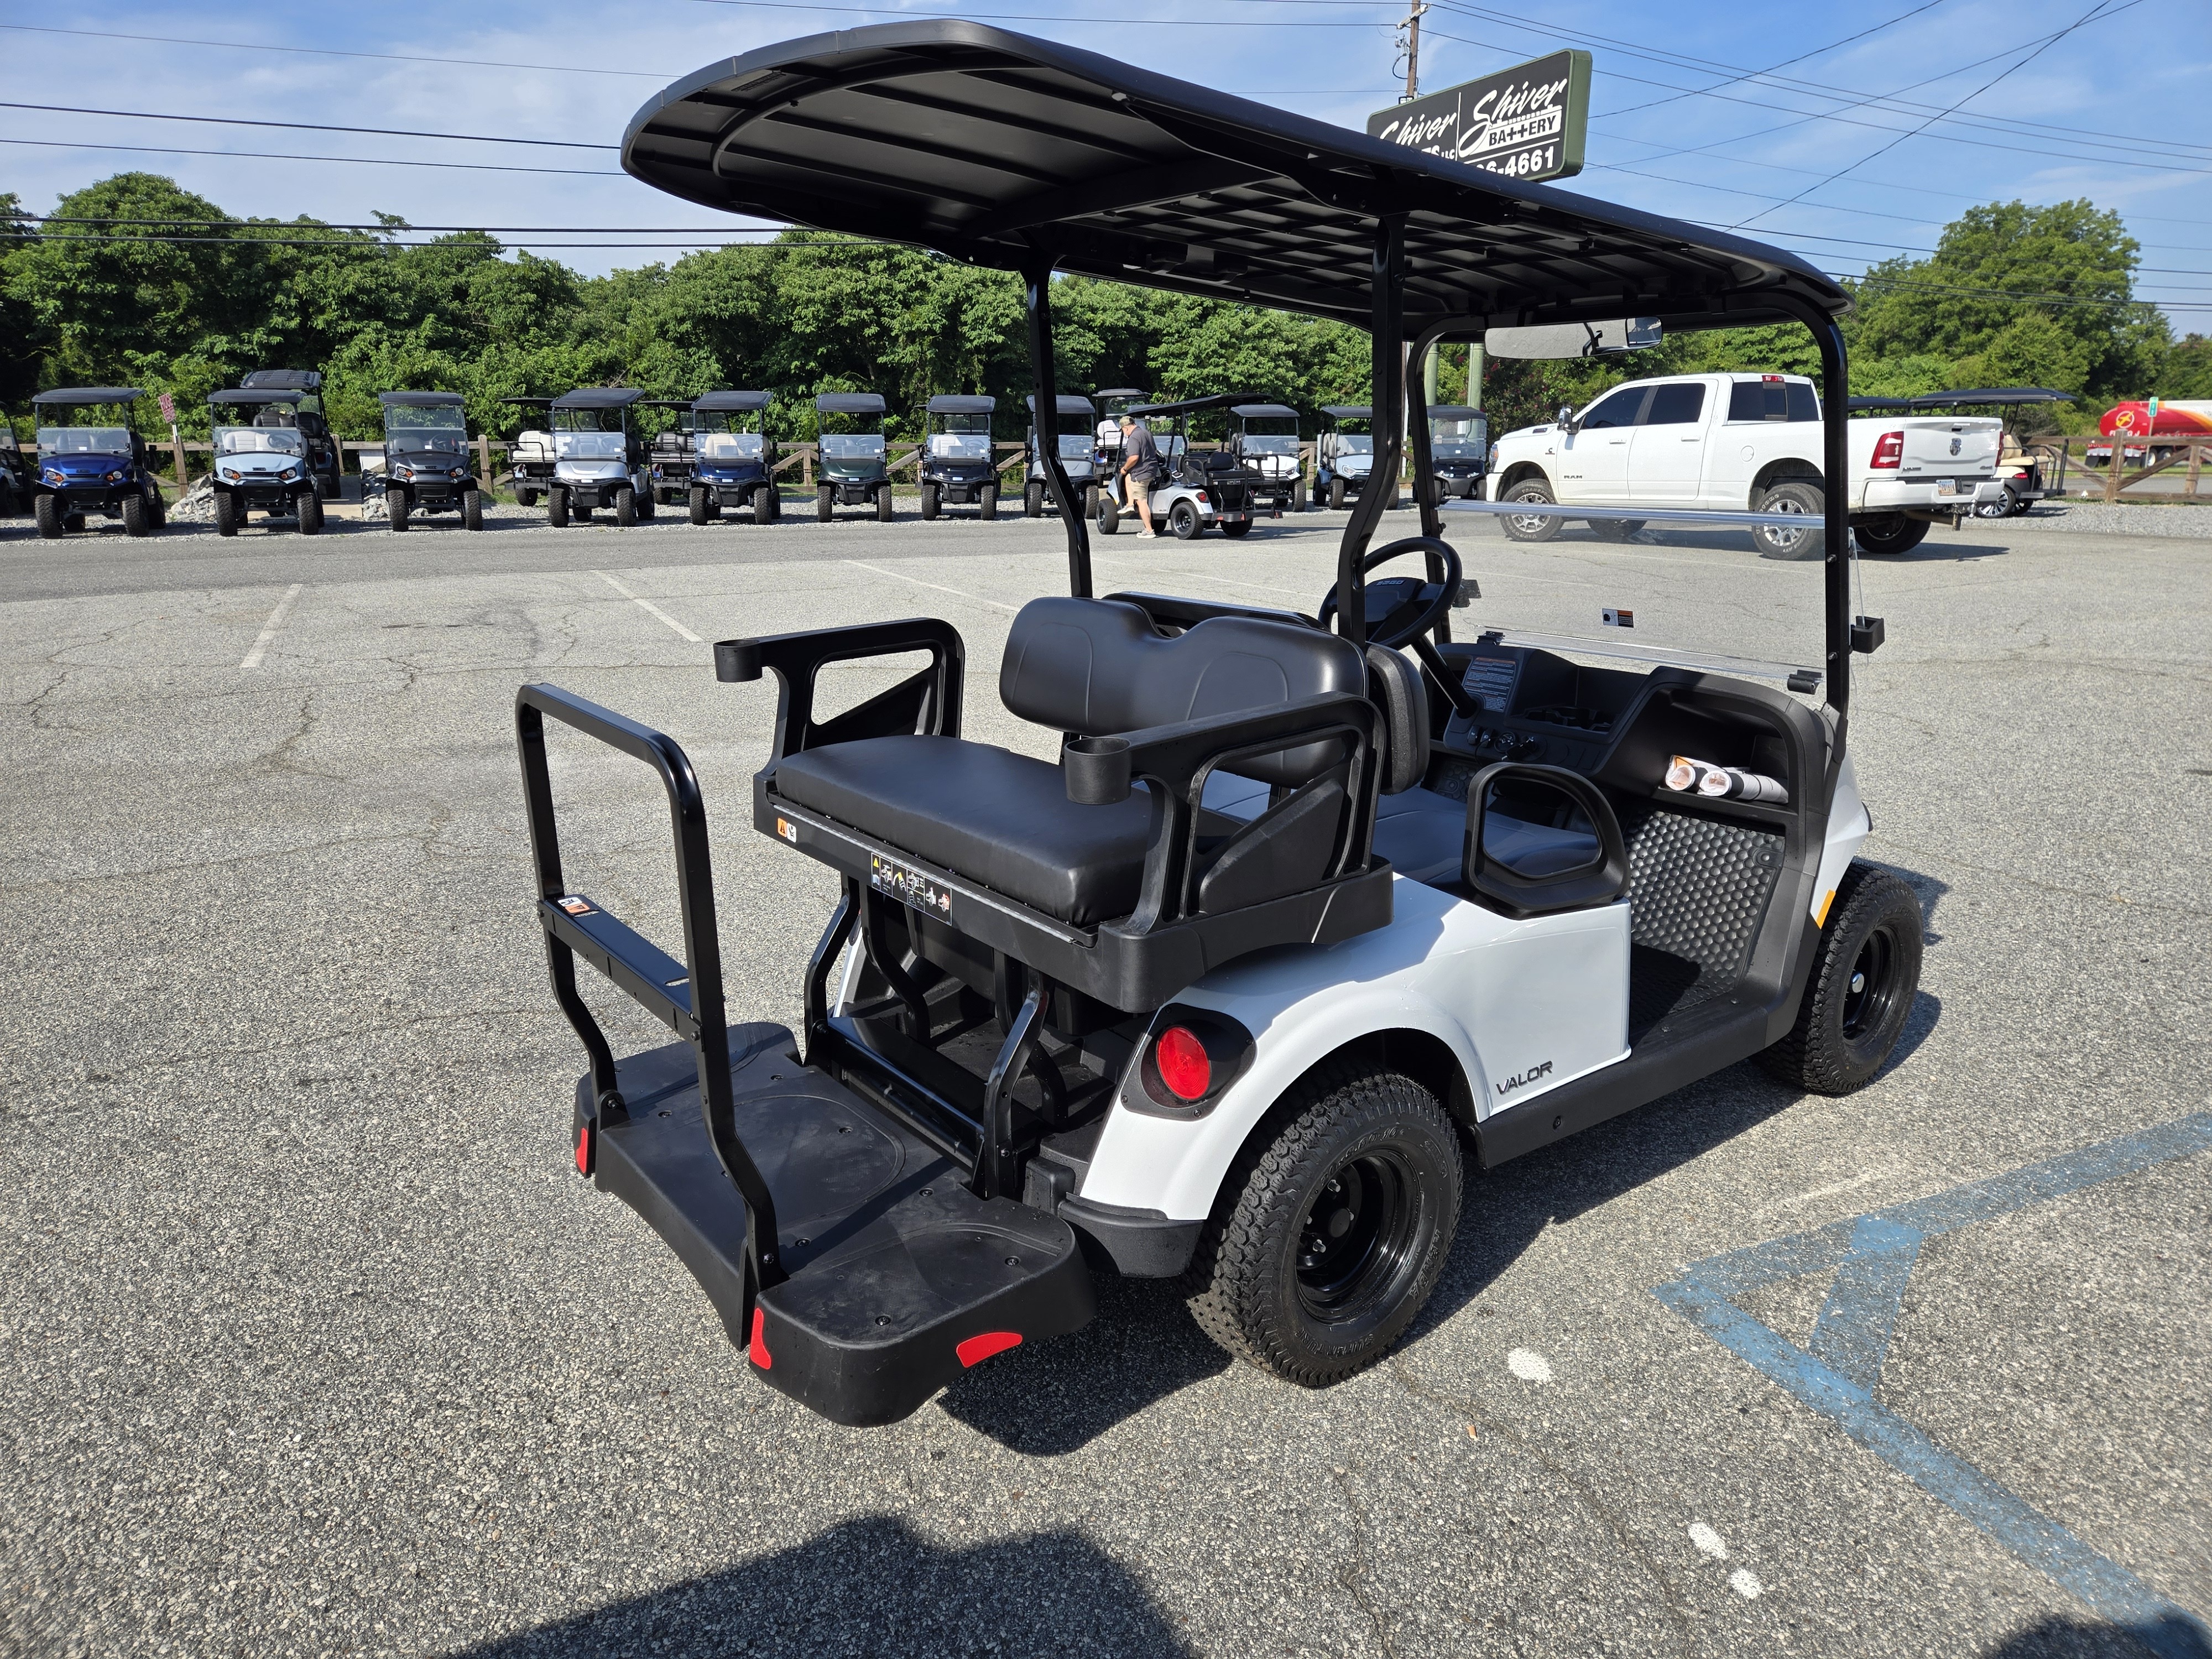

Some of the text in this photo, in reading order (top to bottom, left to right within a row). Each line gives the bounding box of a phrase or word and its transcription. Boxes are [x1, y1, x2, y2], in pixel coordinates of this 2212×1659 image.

[1458, 79, 1567, 158] Shiver
[1477, 146, 1553, 177] 6-4661
[1496, 1061, 1553, 1095] VALOR
[1408, 1229, 1442, 1301] KENDA
